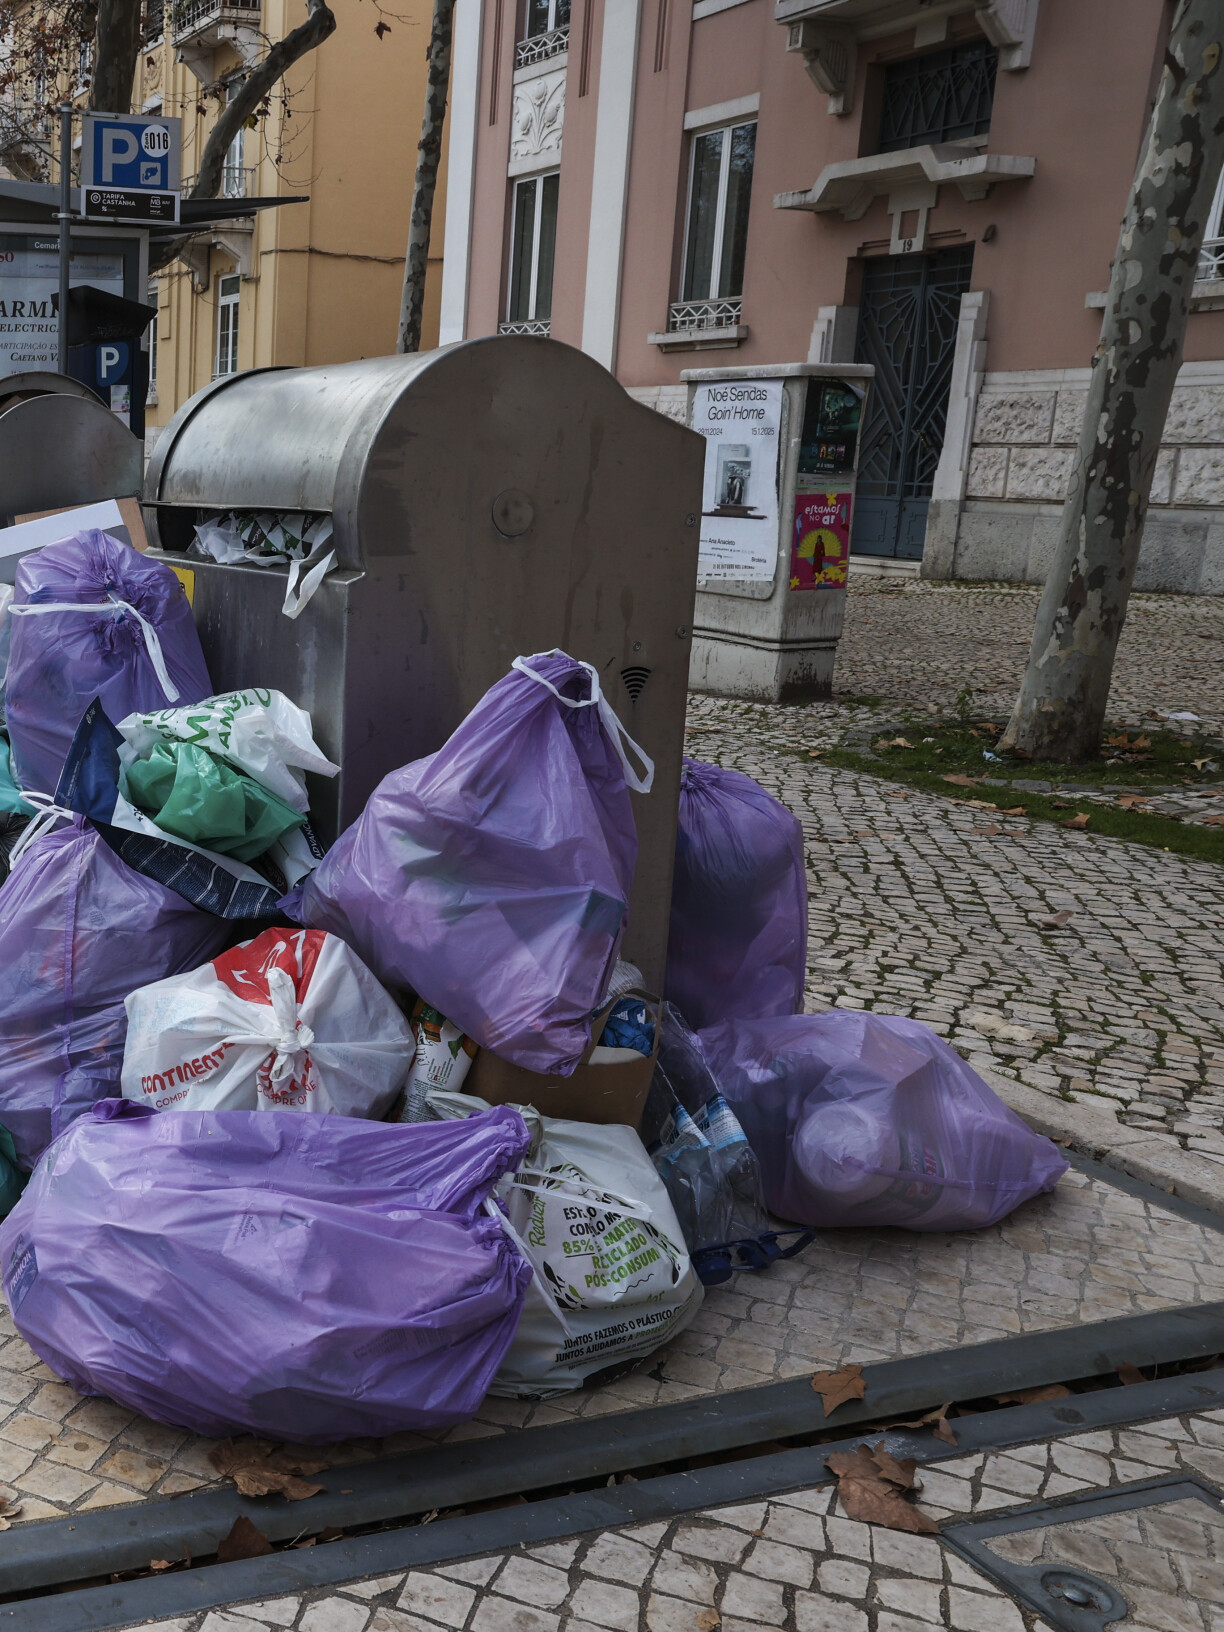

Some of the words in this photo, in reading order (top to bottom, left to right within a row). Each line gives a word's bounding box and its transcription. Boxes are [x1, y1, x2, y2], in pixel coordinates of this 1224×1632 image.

[149, 132, 169, 150] 016
[102, 128, 139, 182] P
[902, 238, 913, 253] 19
[0, 323, 59, 333] ELECTRIC
[101, 346, 120, 379] P
[707, 387, 729, 402] Noé
[729, 387, 768, 402] Sendas
[733, 406, 766, 420] Home
[805, 504, 841, 515] estamos
[821, 514, 836, 525] ar
[528, 1195, 547, 1247] Reduzir
[562, 1238, 595, 1255] 85%
[563, 1332, 593, 1350] JUNTOS
[593, 1322, 629, 1342] FAZEMOS
[628, 1320, 636, 1330] O
[635, 1308, 673, 1328] PLÁSTICO
[554, 1348, 585, 1363] JUNTOS
[585, 1337, 627, 1355] AJUDAMOS
